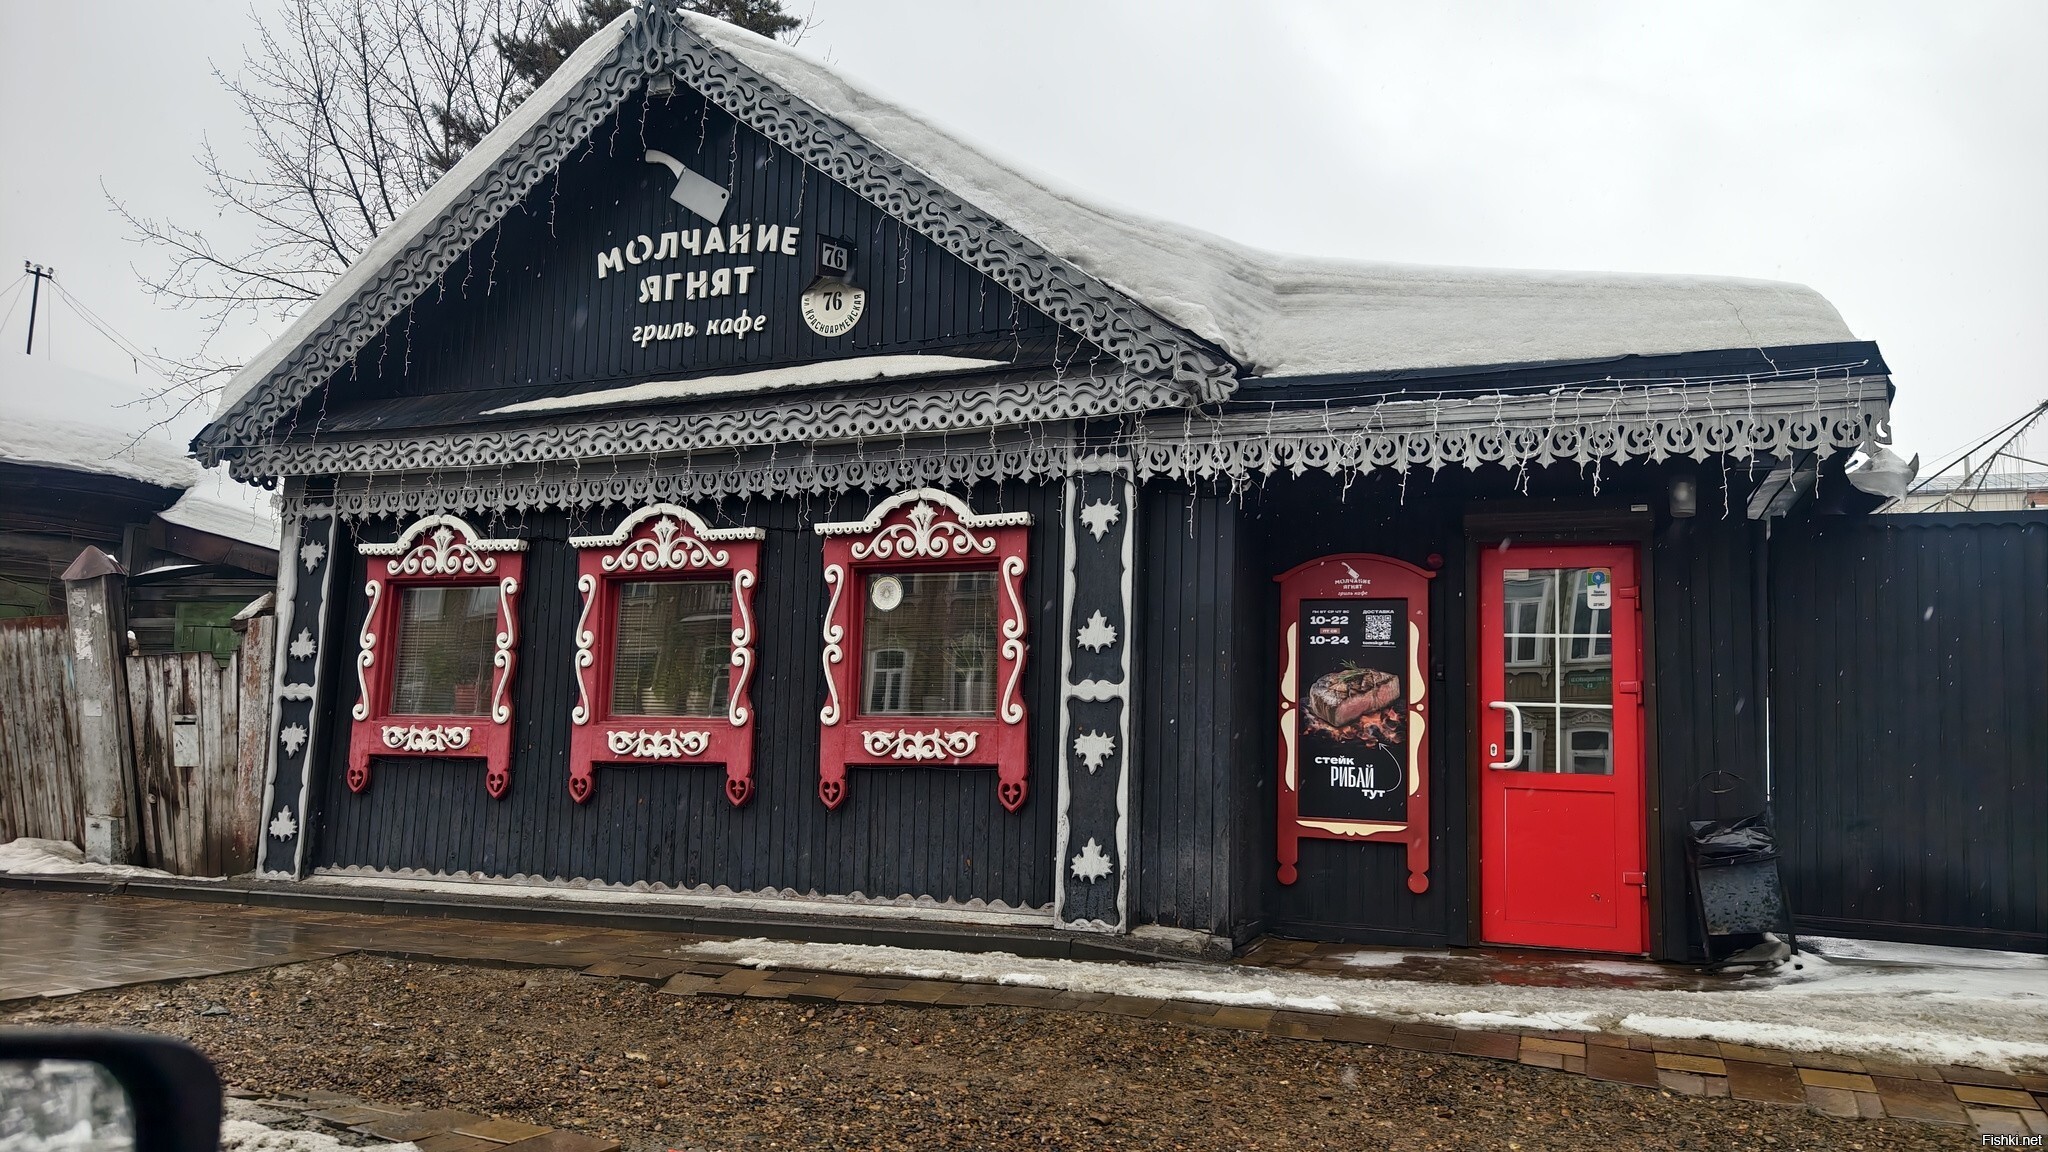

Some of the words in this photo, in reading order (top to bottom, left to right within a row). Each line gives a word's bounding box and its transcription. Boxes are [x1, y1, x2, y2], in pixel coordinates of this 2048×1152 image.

[597, 224, 800, 279] МОЛЧАНИЕ
[824, 246, 843, 268] 76
[639, 266, 756, 303] ЯГНЯТ
[823, 291, 842, 311] 76
[805, 294, 862, 333] КРАСНОАРМЕЙСКАЯ
[632, 319, 695, 348] гриль
[706, 309, 767, 339] кафе
[1310, 616, 1349, 625] 10-22
[1310, 636, 1350, 645] 10-24
[1315, 755, 1354, 765] стейк
[1331, 764, 1374, 788] РИБАЙ
[1362, 789, 1385, 799] тут
